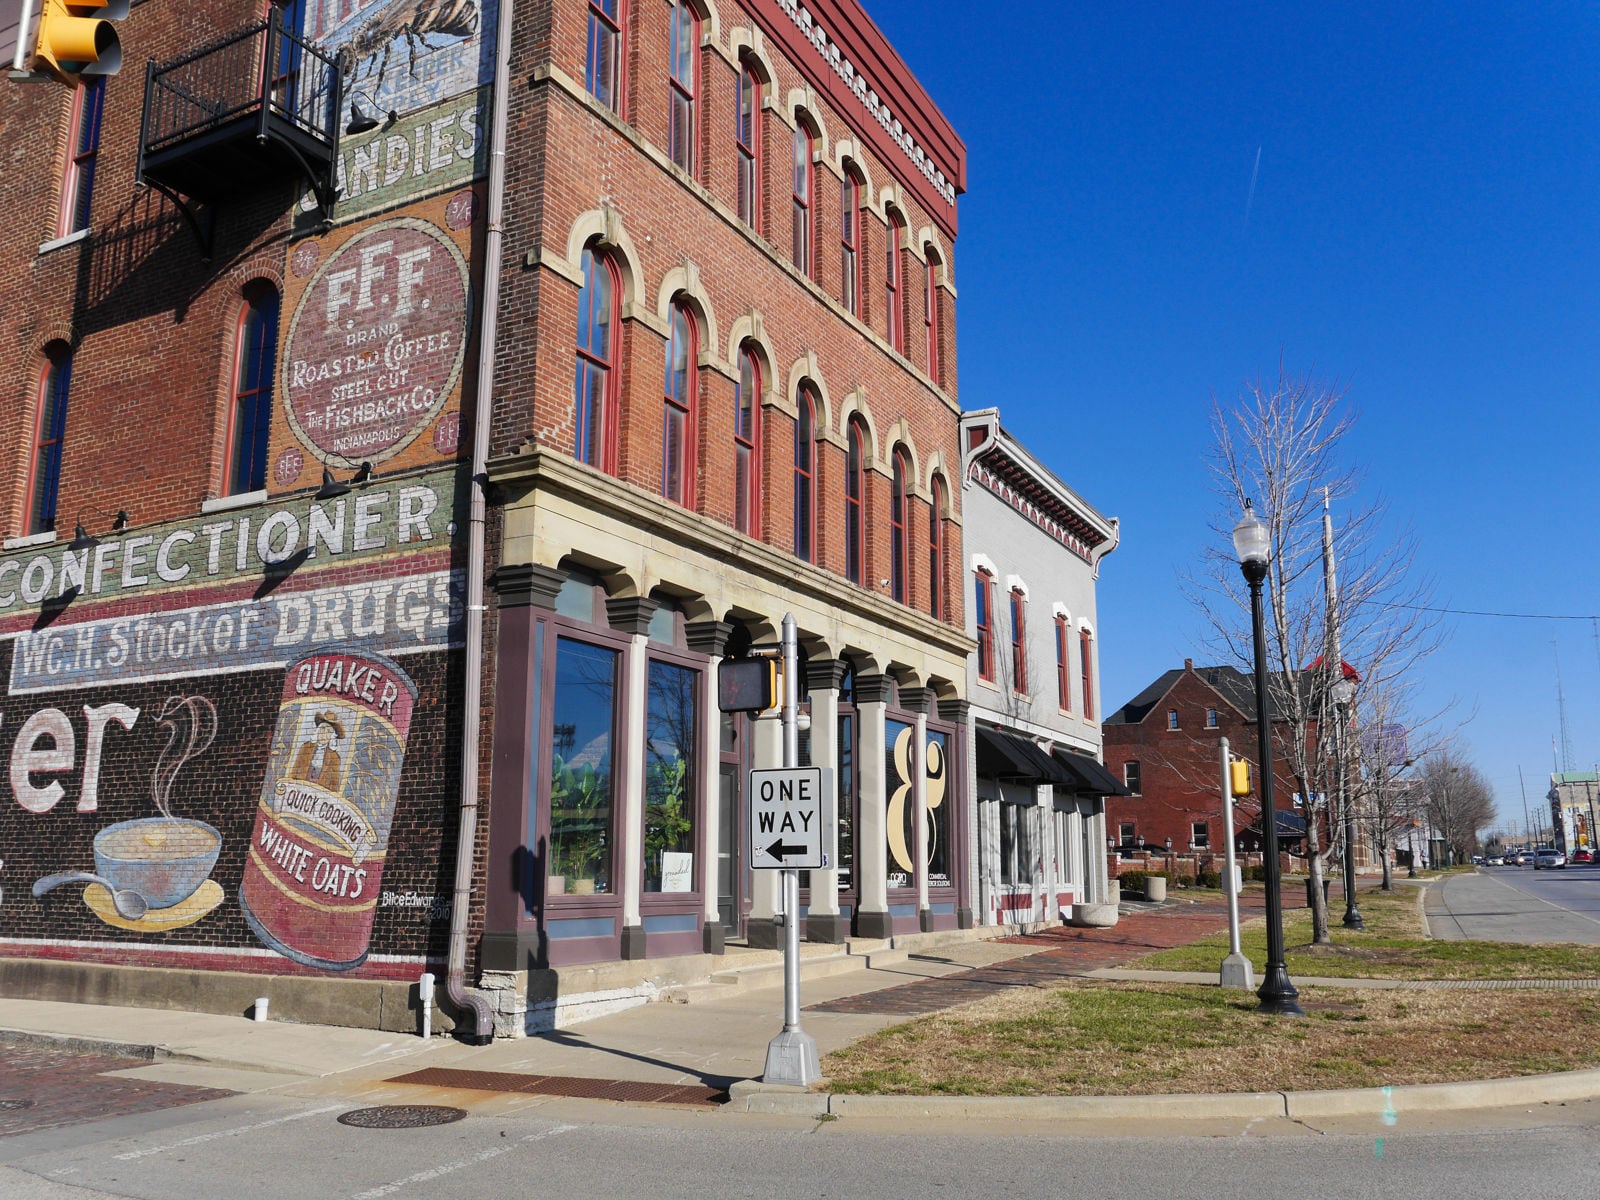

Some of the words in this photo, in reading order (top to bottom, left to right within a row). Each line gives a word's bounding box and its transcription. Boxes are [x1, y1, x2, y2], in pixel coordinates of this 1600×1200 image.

[346, 322, 399, 346] BRAND
[384, 330, 452, 371] COFFEE
[331, 380, 372, 402] STEEL
[377, 369, 409, 391] CUT
[333, 426, 400, 452] INDIANAPOLIS
[273, 568, 466, 647] DRUGS
[295, 658, 398, 716] QUAKER
[10, 703, 141, 814] er
[760, 779, 812, 802] ONE
[287, 789, 320, 815] QUICK
[319, 801, 362, 842] COOKING
[759, 810, 814, 833] WAY
[260, 821, 314, 884] WHITE
[312, 857, 367, 898] OATS
[431, 907, 450, 920] 2010
